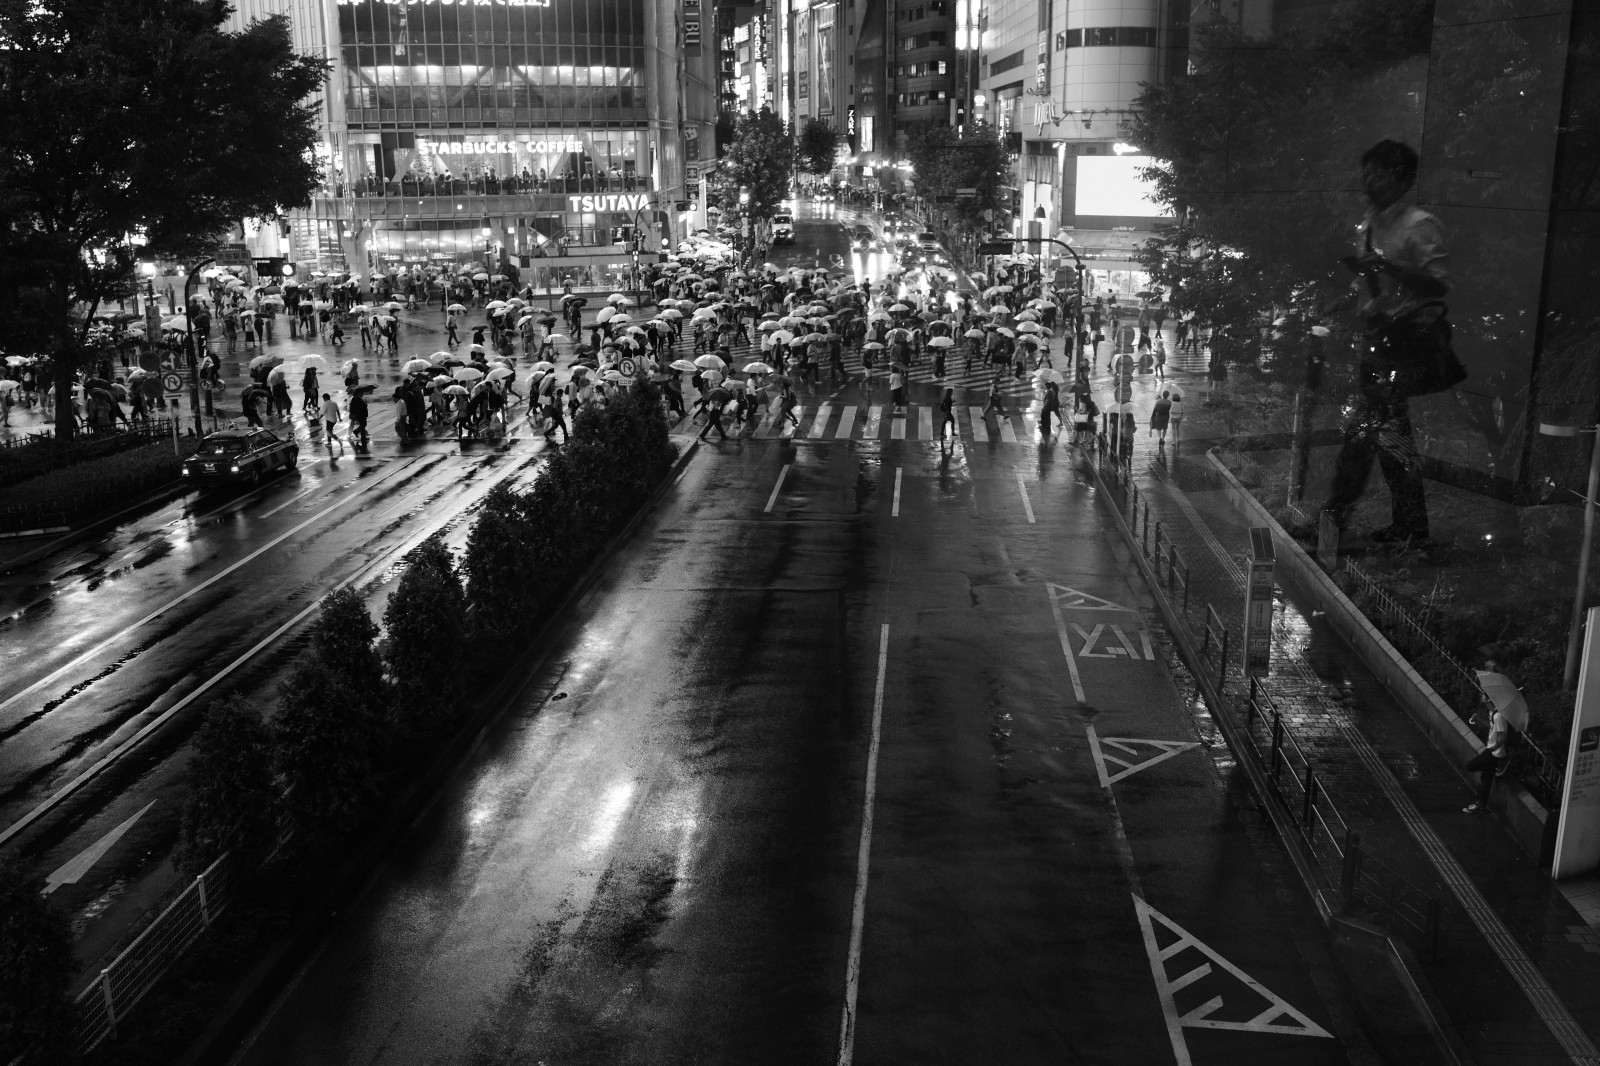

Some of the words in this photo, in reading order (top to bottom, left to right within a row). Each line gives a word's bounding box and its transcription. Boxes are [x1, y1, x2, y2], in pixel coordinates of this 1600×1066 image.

[418, 141, 518, 155] STARBUCKS
[526, 140, 583, 153] COFFEE
[569, 194, 651, 213] TSUTAYA
